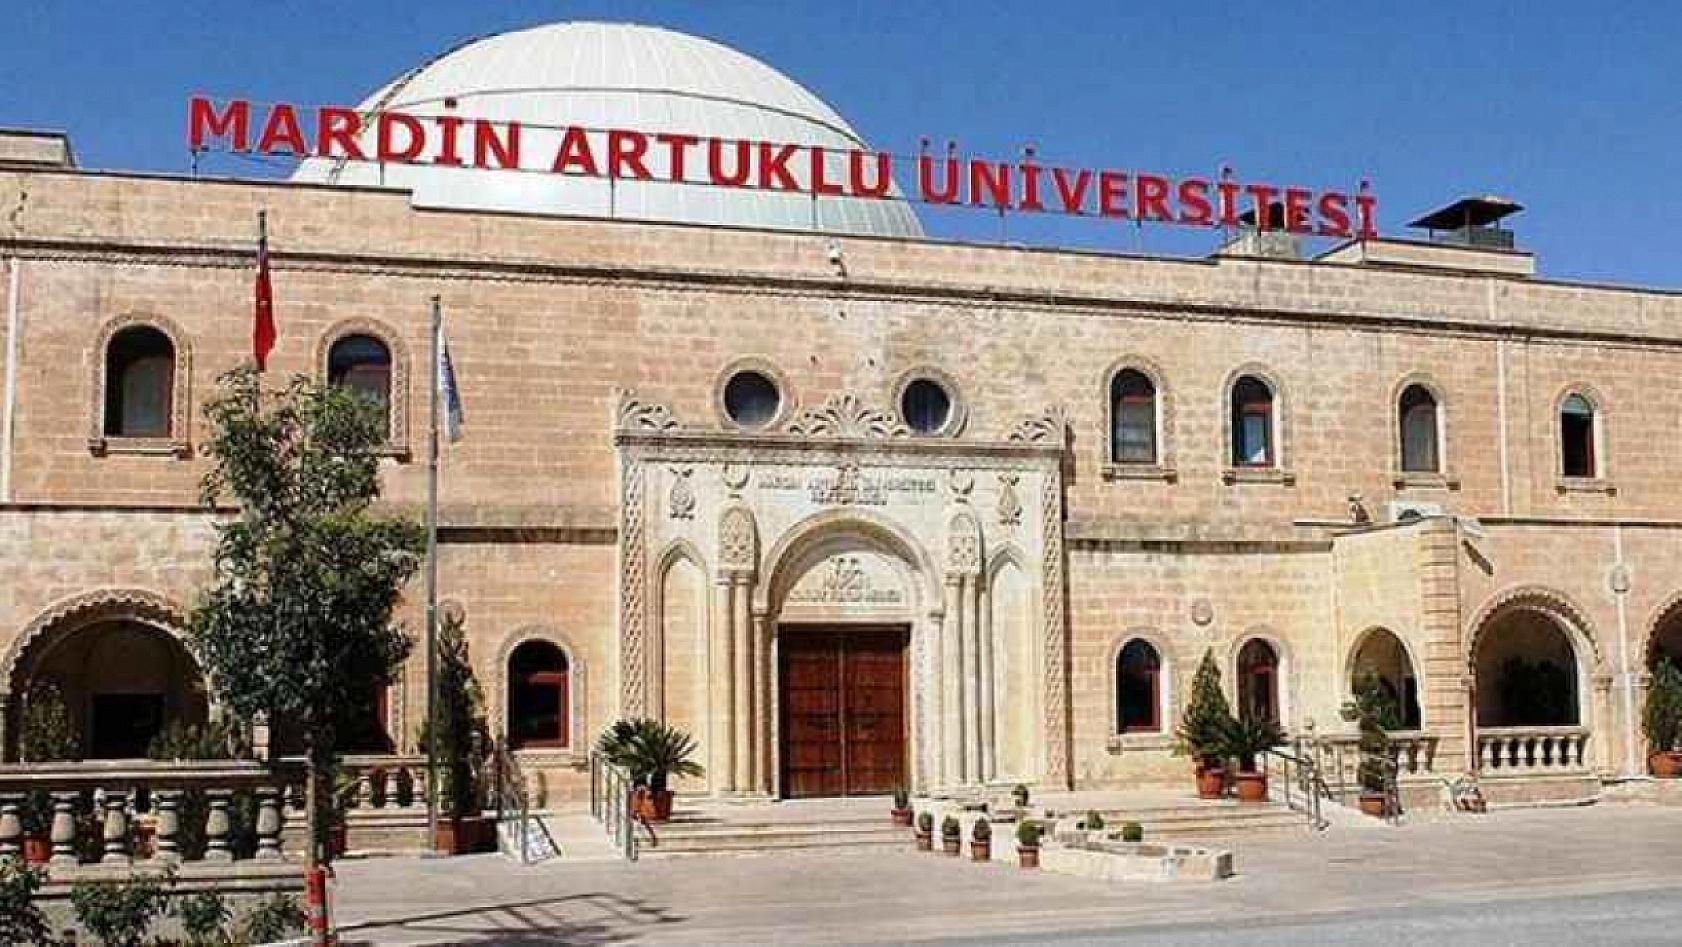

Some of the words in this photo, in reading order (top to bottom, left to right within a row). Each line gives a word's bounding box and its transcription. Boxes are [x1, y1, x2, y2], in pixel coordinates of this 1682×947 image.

[190, 98, 520, 170] MARDİN
[554, 126, 891, 199] ARTUKLU
[919, 138, 1376, 240] ÜNİVERSİTESİ
